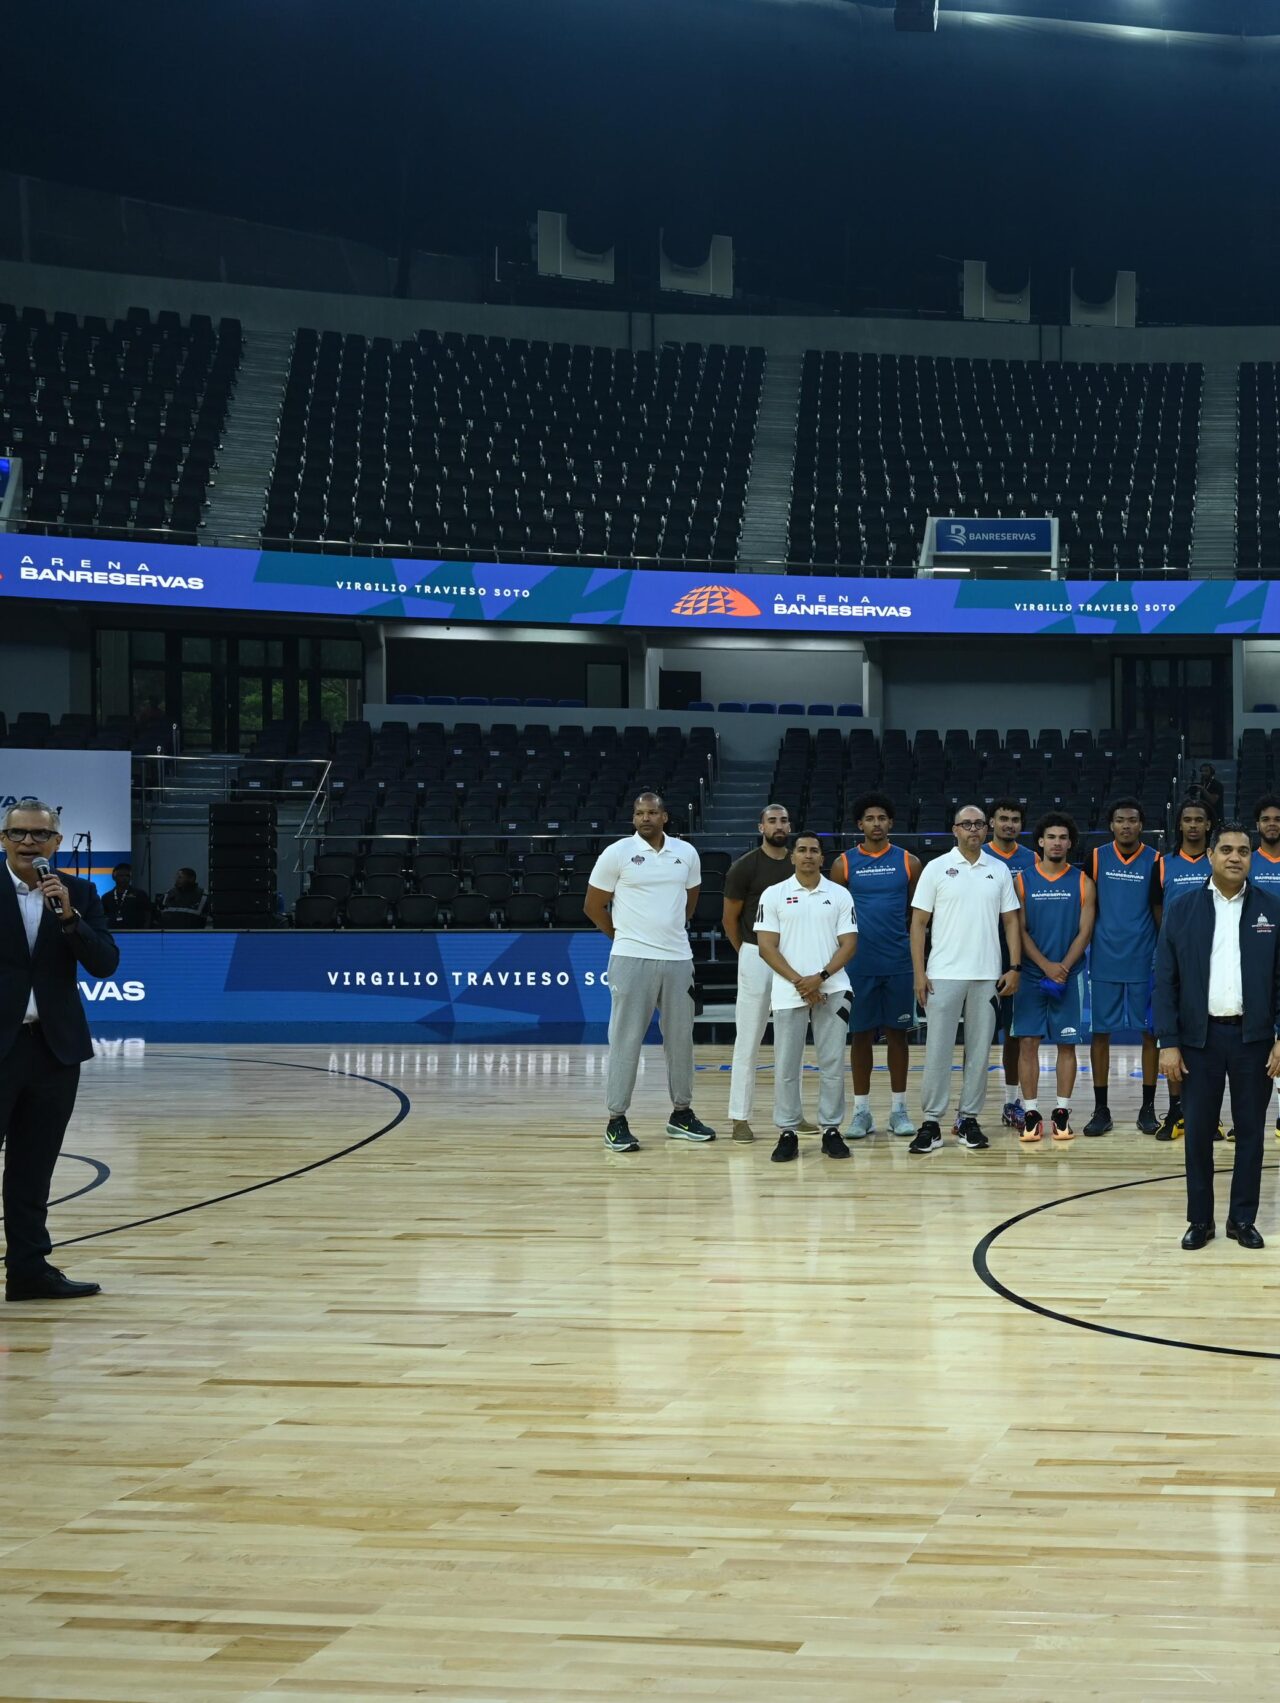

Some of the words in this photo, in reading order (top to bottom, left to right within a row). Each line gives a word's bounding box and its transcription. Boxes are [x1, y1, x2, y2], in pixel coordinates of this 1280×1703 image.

[969, 532, 1037, 541] BANRESERVAS
[20, 555, 150, 572] ARENA
[20, 567, 205, 590] BANRESERVAS
[336, 581, 408, 593] VIRGILIO
[414, 584, 487, 596] TRAVIESO
[494, 588, 531, 598] SOTO
[774, 593, 870, 604] ARENA
[774, 603, 912, 618] BANRESERVAS
[1014, 603, 1073, 612] VIRGILIO
[1079, 603, 1139, 612] TRAVIESO
[1144, 603, 1176, 612] SOTO
[327, 971, 439, 986] VIRGILIO
[451, 971, 570, 986] TRAVIESO
[77, 981, 146, 1001] VAS
